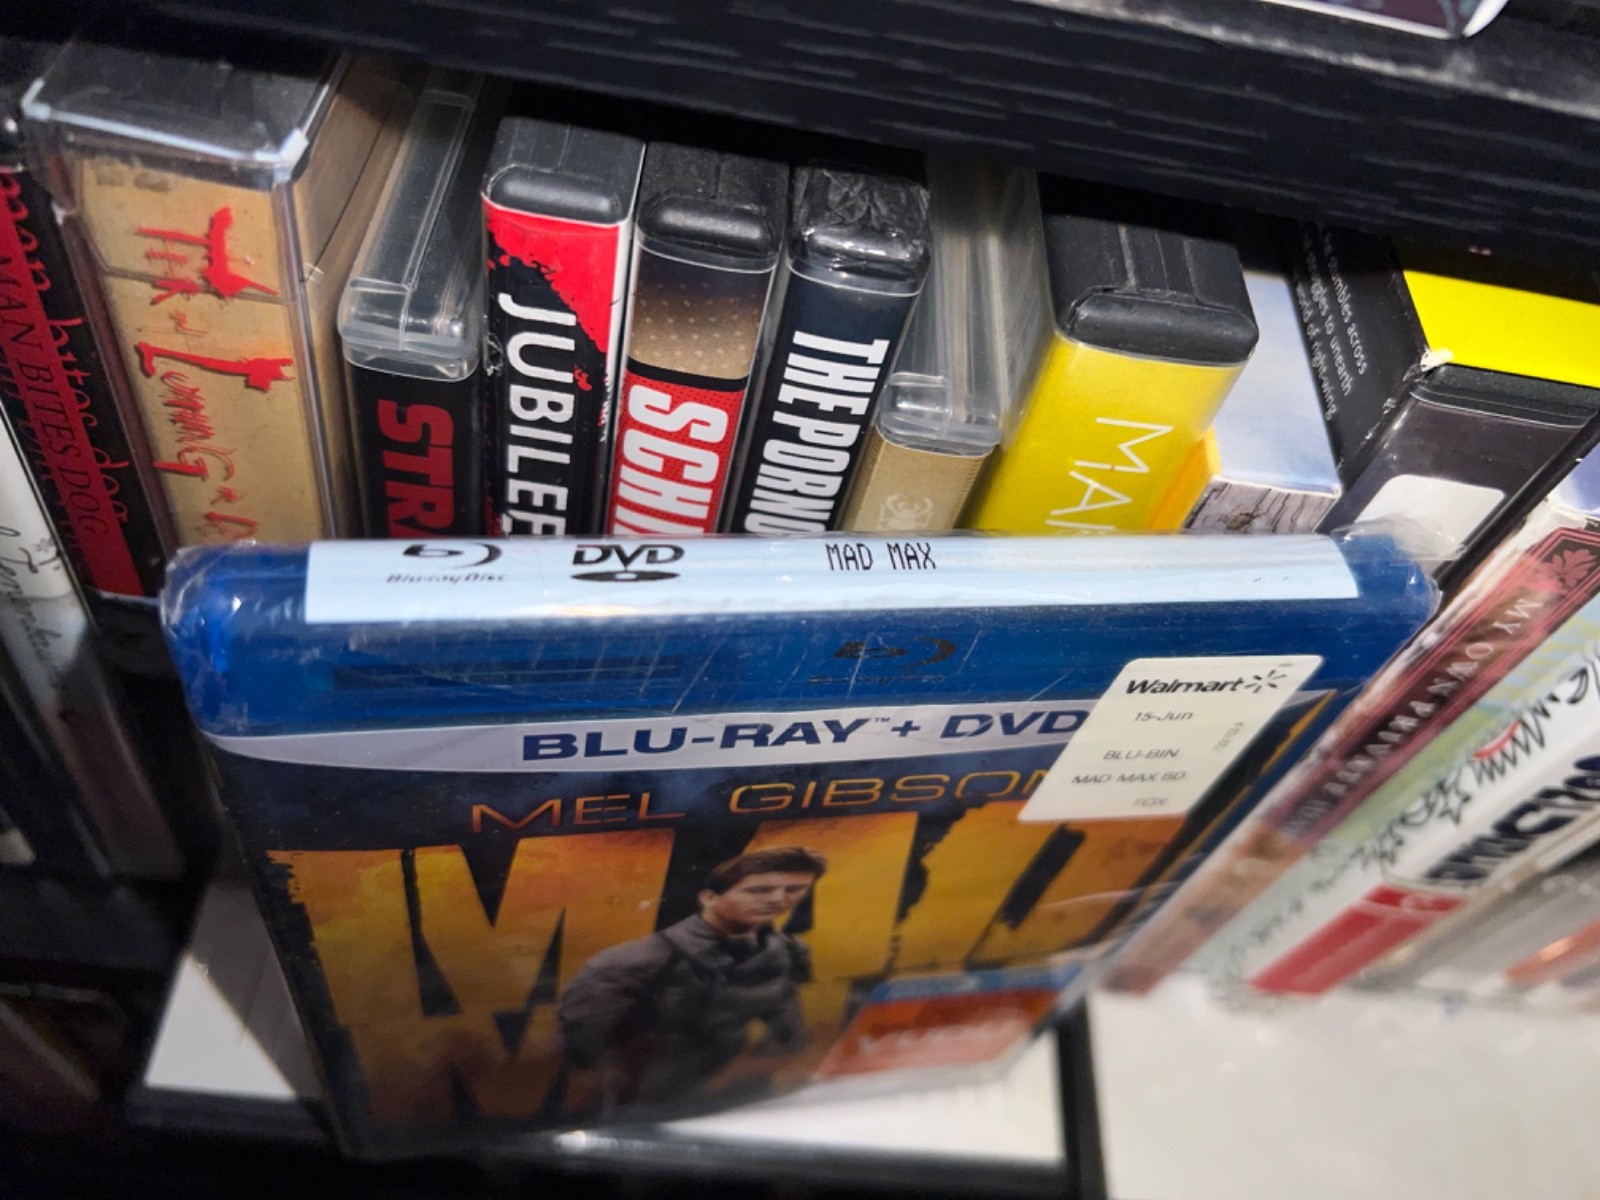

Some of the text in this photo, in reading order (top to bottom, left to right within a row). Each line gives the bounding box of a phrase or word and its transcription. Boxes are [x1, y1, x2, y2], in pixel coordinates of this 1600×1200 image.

[1306, 322, 1320, 340] of
[1324, 313, 1335, 335] to
[1346, 322, 1368, 376] across
[778, 330, 890, 416] THE
[1329, 334, 1353, 397] unearth
[498, 292, 577, 537] JUBILEE
[18, 361, 83, 459] BITES
[57, 464, 109, 536] DOG
[612, 384, 729, 536] SCHI
[572, 544, 686, 568] DVD
[825, 542, 937, 571] MAD MAX
[1492, 597, 1544, 635] MY
[1125, 678, 1246, 695] Walmart
[891, 720, 921, 738] +
[940, 709, 1091, 739] DVD
[1133, 710, 1194, 722] 15-Jun
[1102, 748, 1181, 761] BLU-BIN
[1071, 774, 1112, 785] MAD
[1116, 772, 1158, 783] MAX
[471, 792, 686, 834] MEL
